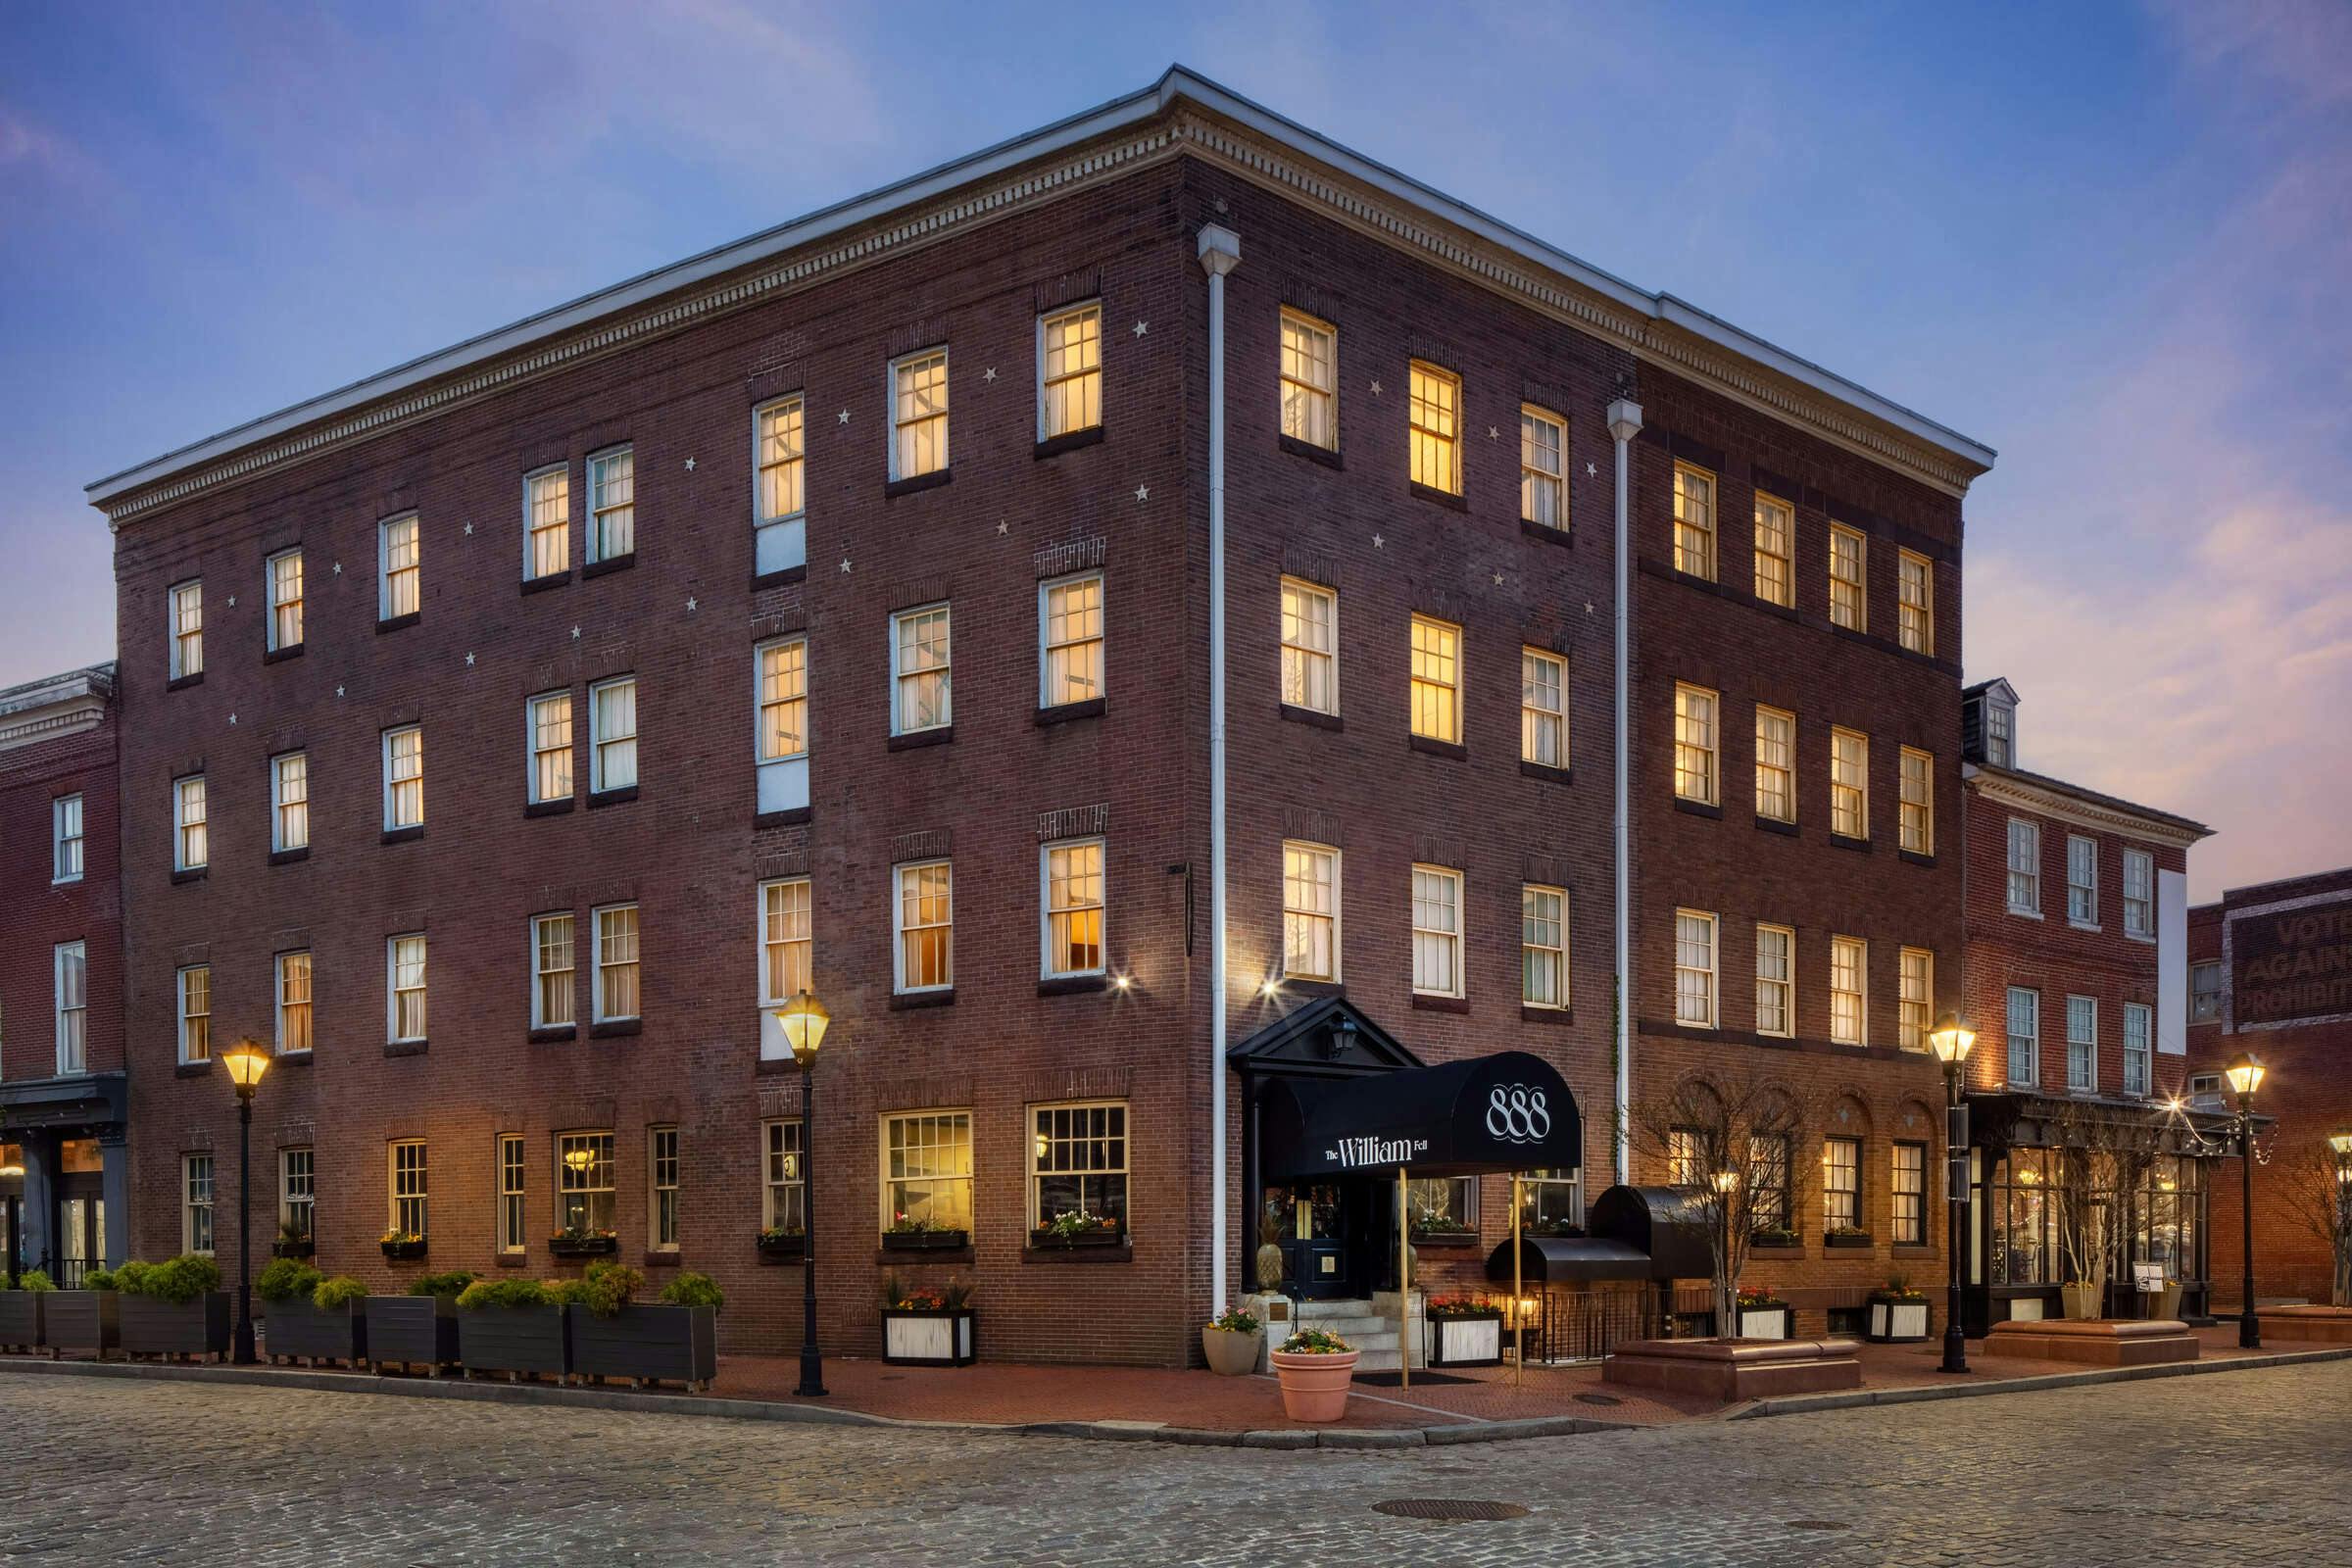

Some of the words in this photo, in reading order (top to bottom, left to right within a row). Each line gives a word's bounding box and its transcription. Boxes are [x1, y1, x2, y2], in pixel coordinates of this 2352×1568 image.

[1486, 1089, 1550, 1139] 888
[1325, 1150, 1339, 1160] The
[1338, 1137, 1412, 1167] William
[1414, 1140, 1428, 1151] Fell
